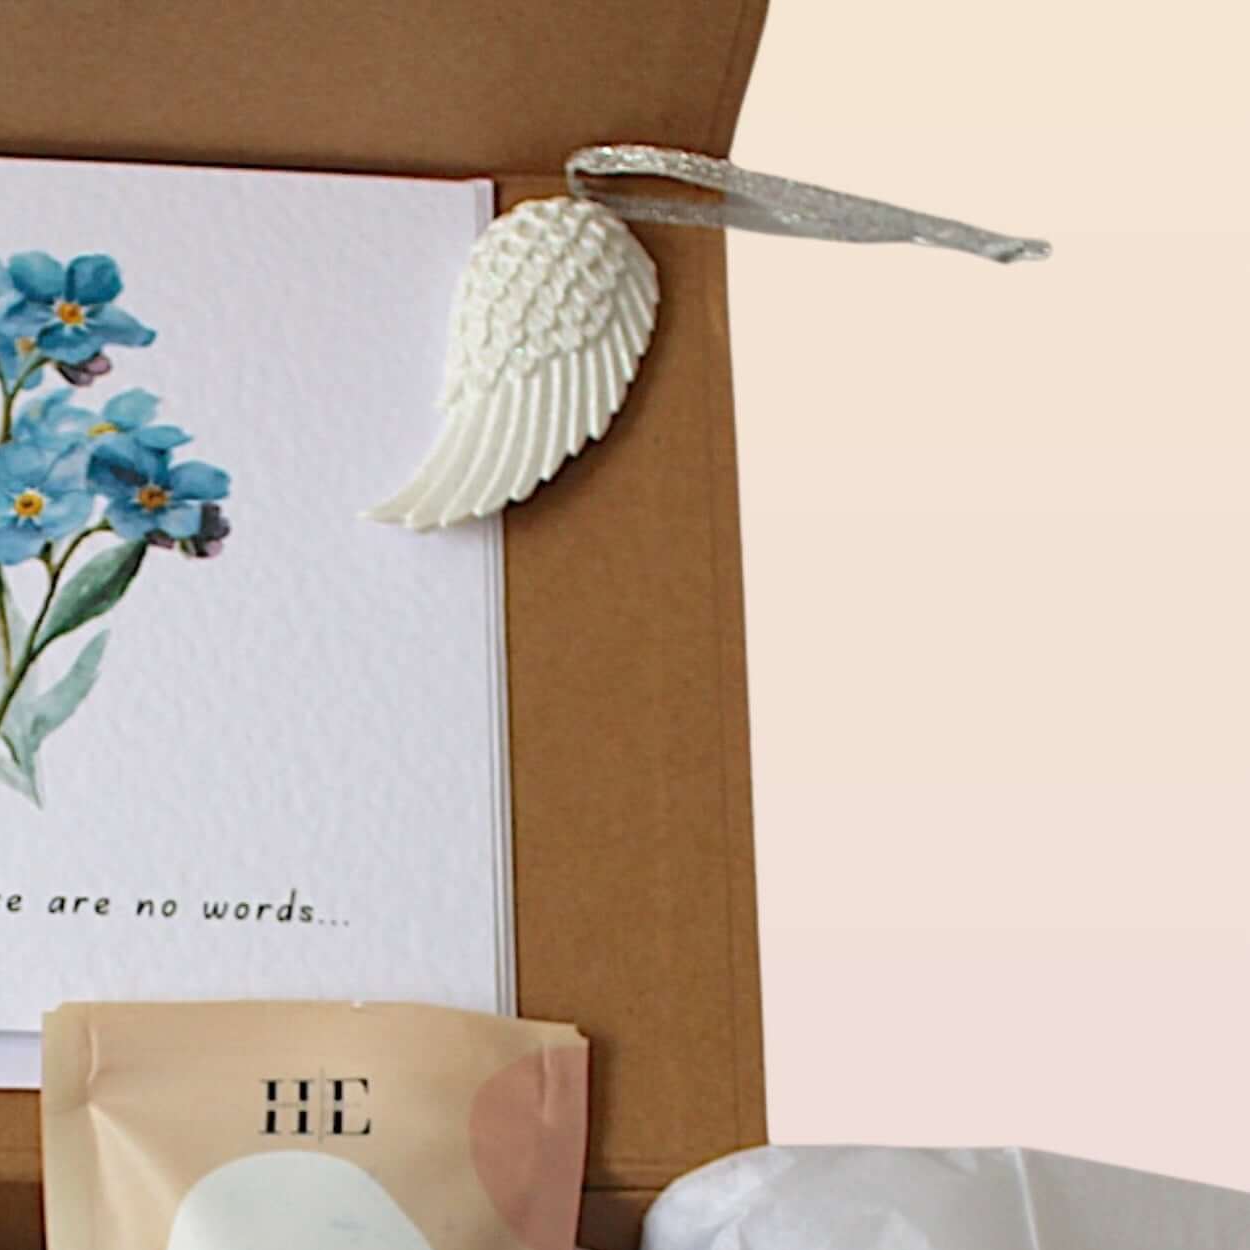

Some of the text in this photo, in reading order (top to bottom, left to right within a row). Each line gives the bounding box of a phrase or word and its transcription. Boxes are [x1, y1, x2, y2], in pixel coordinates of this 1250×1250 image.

[48, 894, 110, 915] are
[136, 897, 178, 918] no
[203, 888, 350, 927] words...
